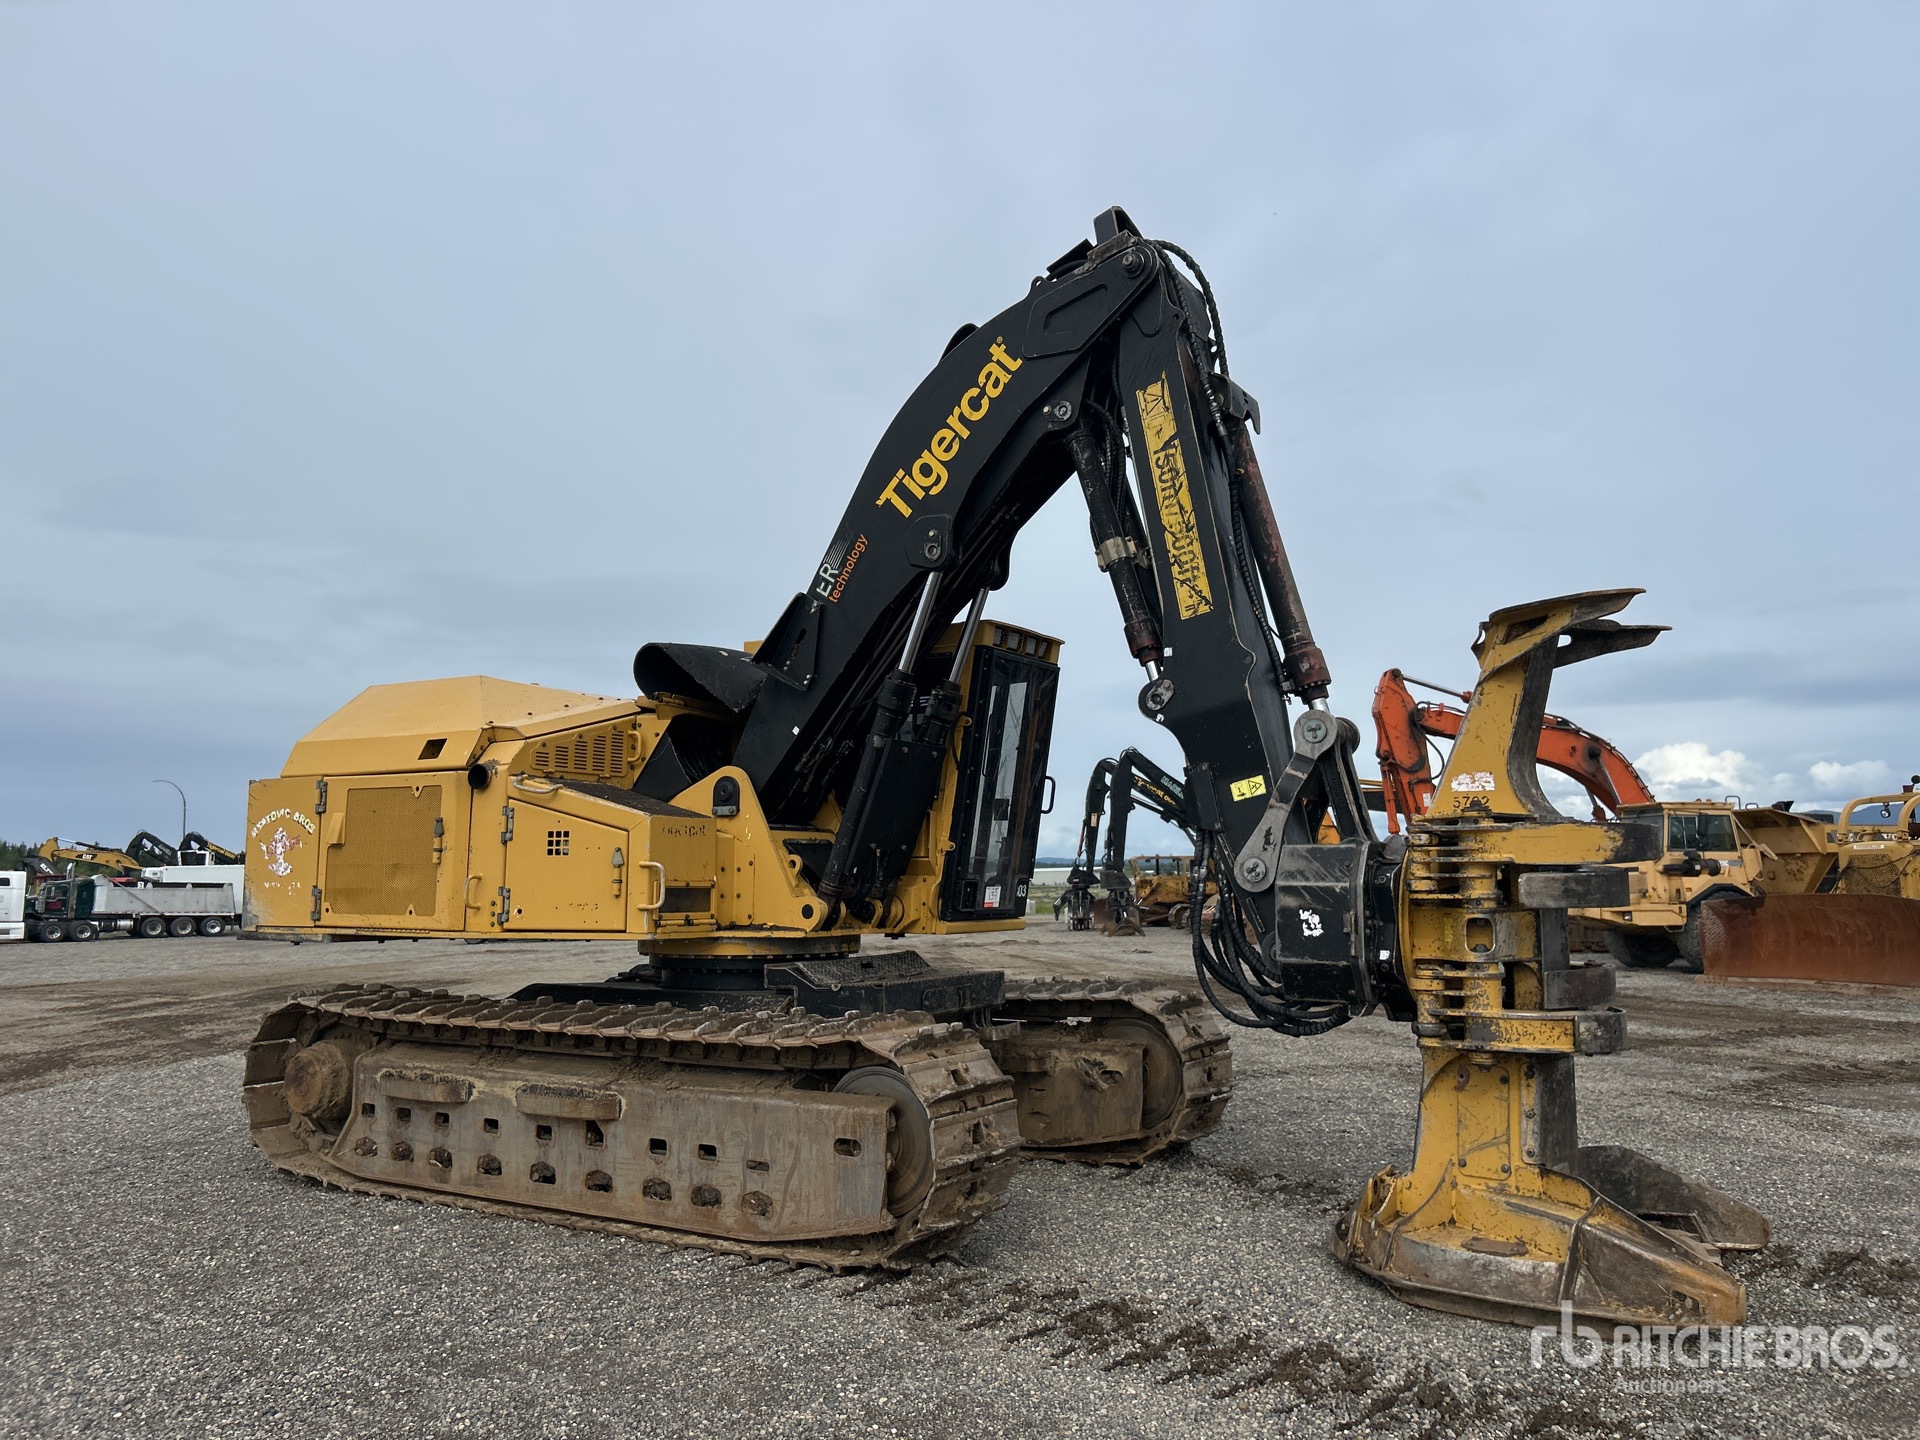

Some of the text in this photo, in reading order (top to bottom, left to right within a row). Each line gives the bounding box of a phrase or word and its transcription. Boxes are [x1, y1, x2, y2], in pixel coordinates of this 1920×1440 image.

[876, 343, 1023, 518] Tigercat
[829, 534, 868, 603] technology
[293, 811, 316, 835] BROS
